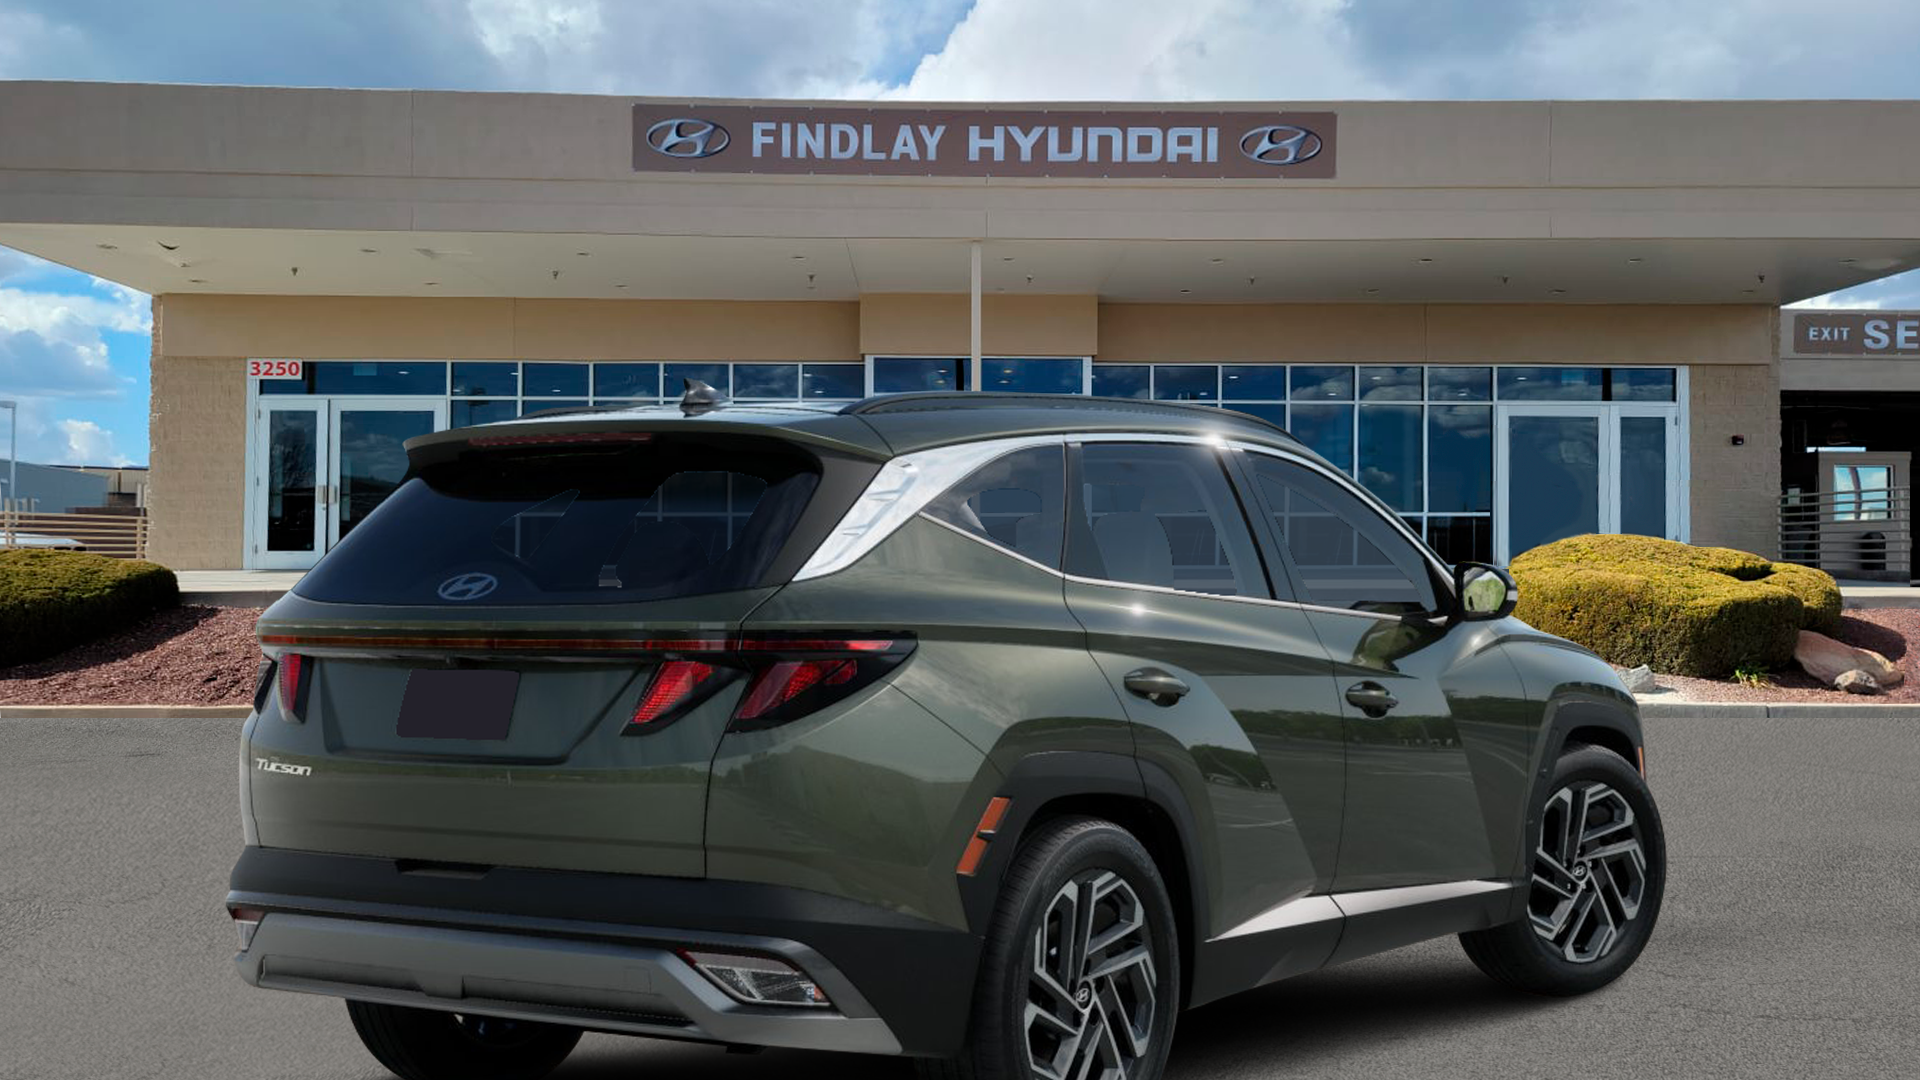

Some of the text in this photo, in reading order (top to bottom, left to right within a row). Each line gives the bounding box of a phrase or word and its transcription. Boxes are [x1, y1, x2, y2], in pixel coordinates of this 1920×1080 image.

[752, 122, 1219, 162] FINDLAY HYUNDAI
[1808, 319, 1920, 350] EXIT SE
[249, 361, 300, 376] 3250
